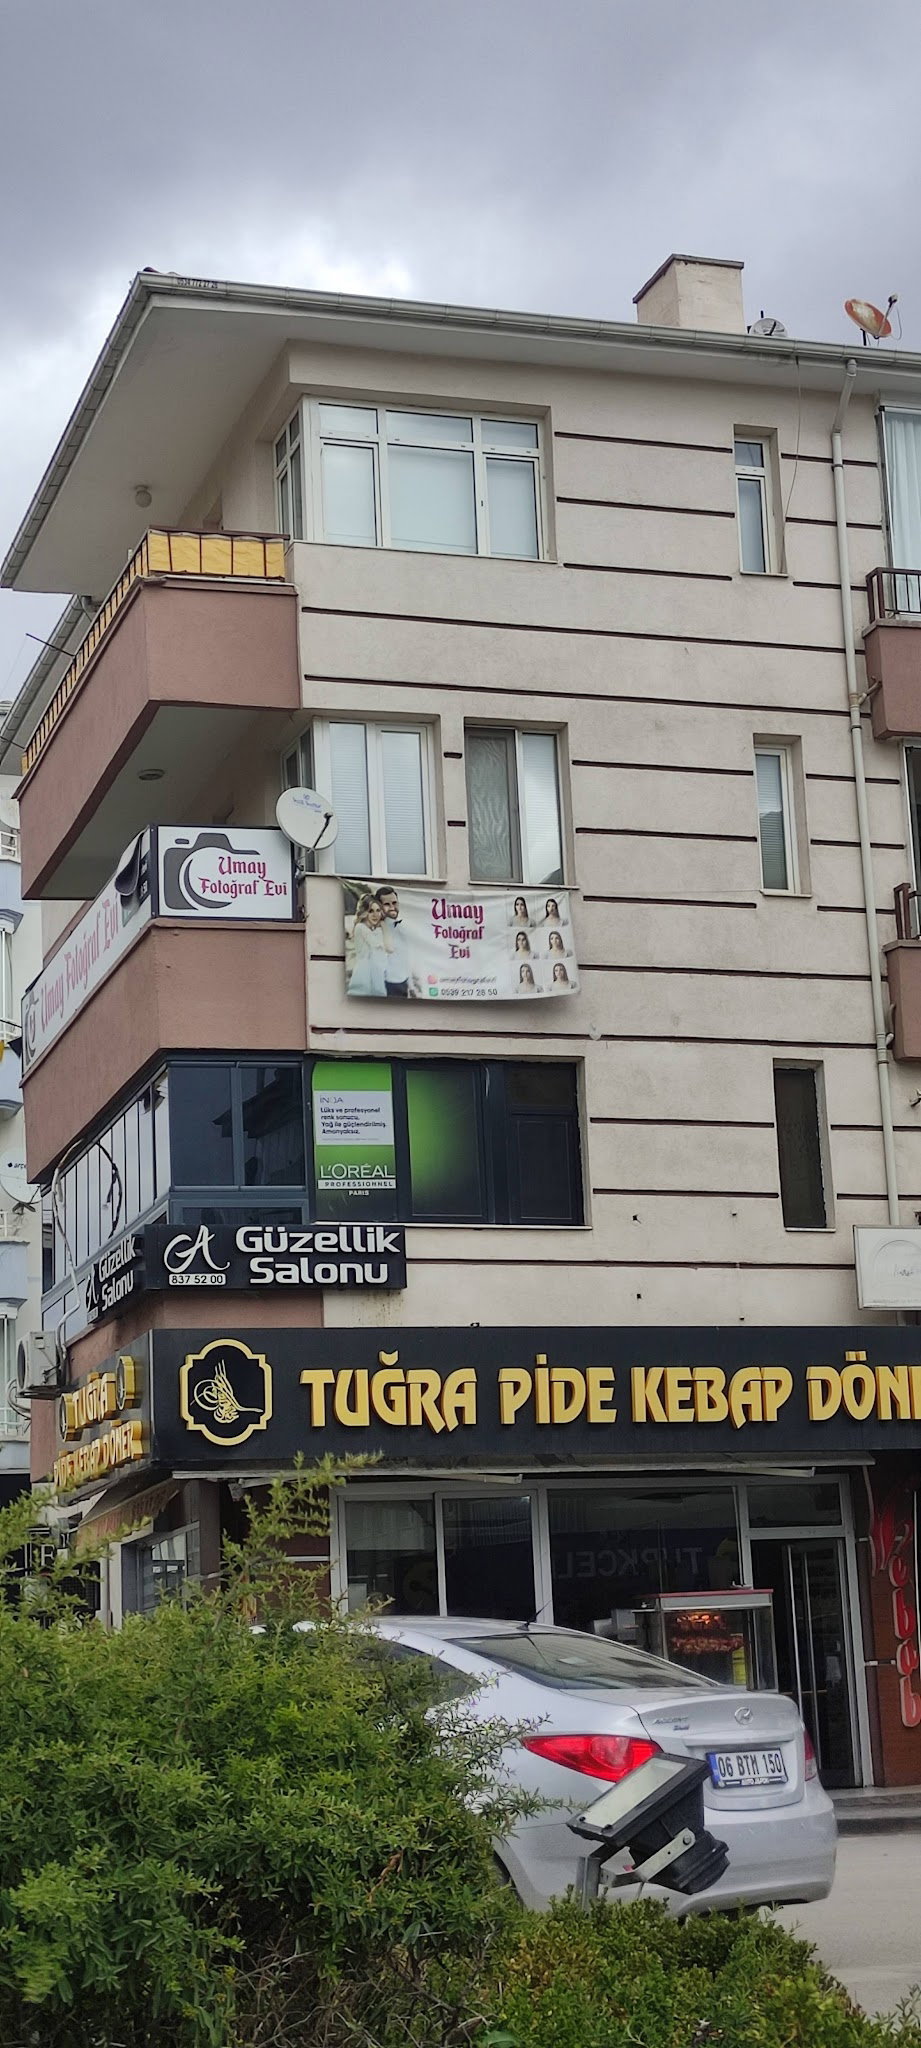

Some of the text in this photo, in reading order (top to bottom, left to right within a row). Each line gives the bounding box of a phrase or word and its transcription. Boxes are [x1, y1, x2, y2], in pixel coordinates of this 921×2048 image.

[218, 856, 267, 879] Umay
[198, 877, 288, 899] Fotoğraf Evi
[431, 898, 484, 924] Umay
[431, 923, 485, 943] Fotoğraf
[41, 893, 120, 1033] Umay Fotoğraf Evi
[448, 943, 471, 959] Evi
[488, 988, 498, 996] 50
[235, 1226, 401, 1253] Güzellik
[99, 1234, 136, 1282] Güzellik
[249, 1257, 389, 1284] Salonu
[102, 1270, 134, 1312] Salonu
[172, 1275, 223, 1284] 837 52 00
[300, 1350, 478, 1433] TUĞRA
[498, 1354, 618, 1425] PİDE
[631, 1366, 794, 1429] KEBAP
[718, 1756, 733, 1777] 06
[762, 1753, 782, 1773] 150
